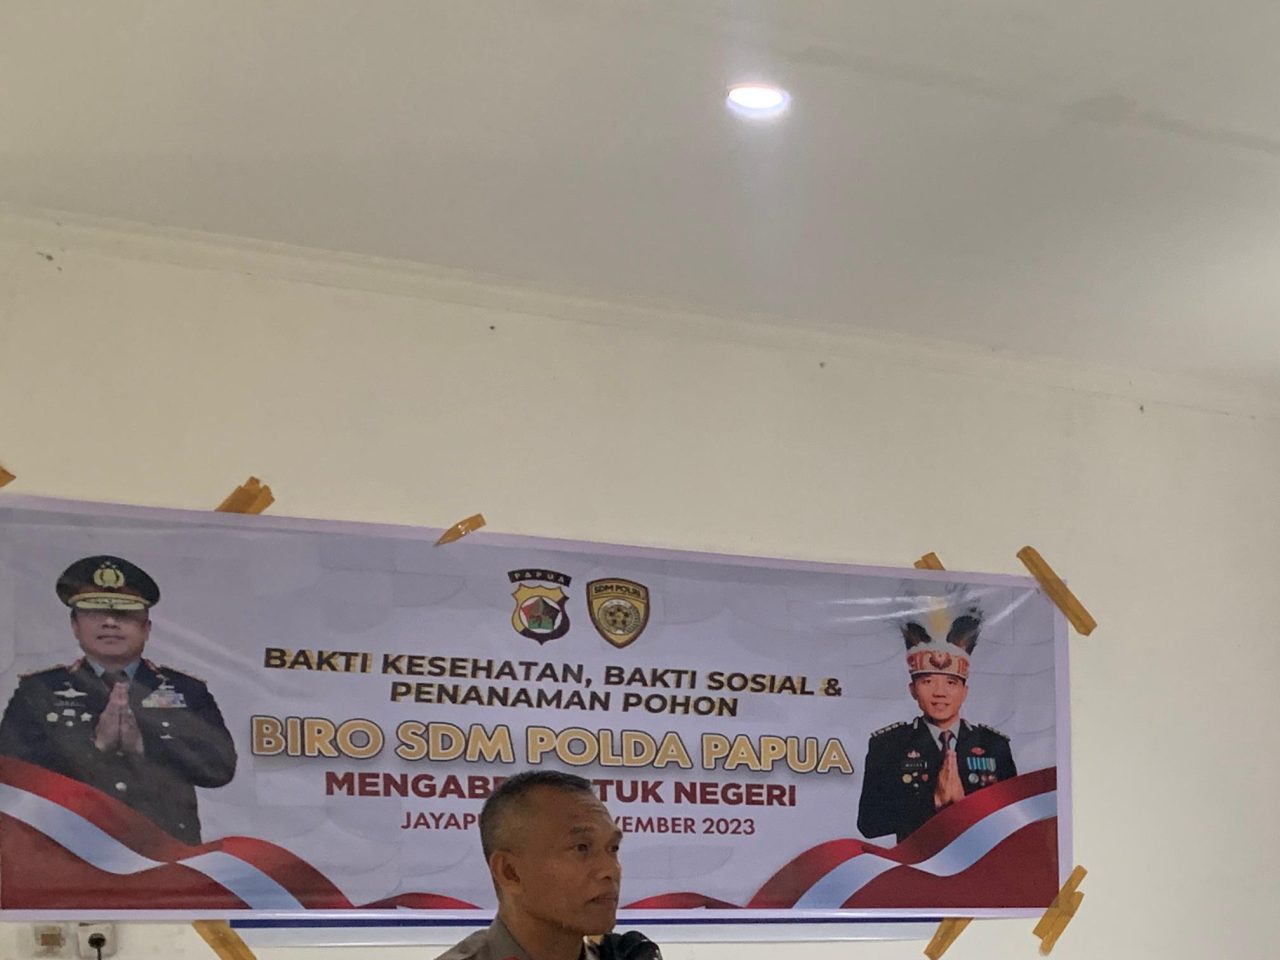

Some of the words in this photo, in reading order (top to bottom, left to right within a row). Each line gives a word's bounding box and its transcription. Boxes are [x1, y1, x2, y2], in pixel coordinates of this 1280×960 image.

[514, 571, 565, 583] PAPUA
[594, 584, 614, 594] SDM
[615, 584, 641, 597] POLRI
[264, 648, 370, 673] BAKTI
[382, 653, 592, 688] KESEHATAN,
[604, 665, 697, 690] BAKTI
[707, 671, 814, 697] SOSIAL
[823, 677, 843, 697] &
[390, 681, 611, 711] PENANAMAN
[622, 692, 738, 717] POHON
[251, 715, 385, 760] BIRO
[394, 720, 515, 764] SDM
[525, 724, 693, 769] POLDA
[701, 732, 854, 775] PAPUA
[325, 771, 507, 799] MENGAB
[591, 778, 664, 804] TUK
[674, 781, 797, 807] NEGERI
[401, 812, 481, 830] JAYAP
[614, 816, 697, 833] EMBER
[702, 818, 756, 836] 2023
